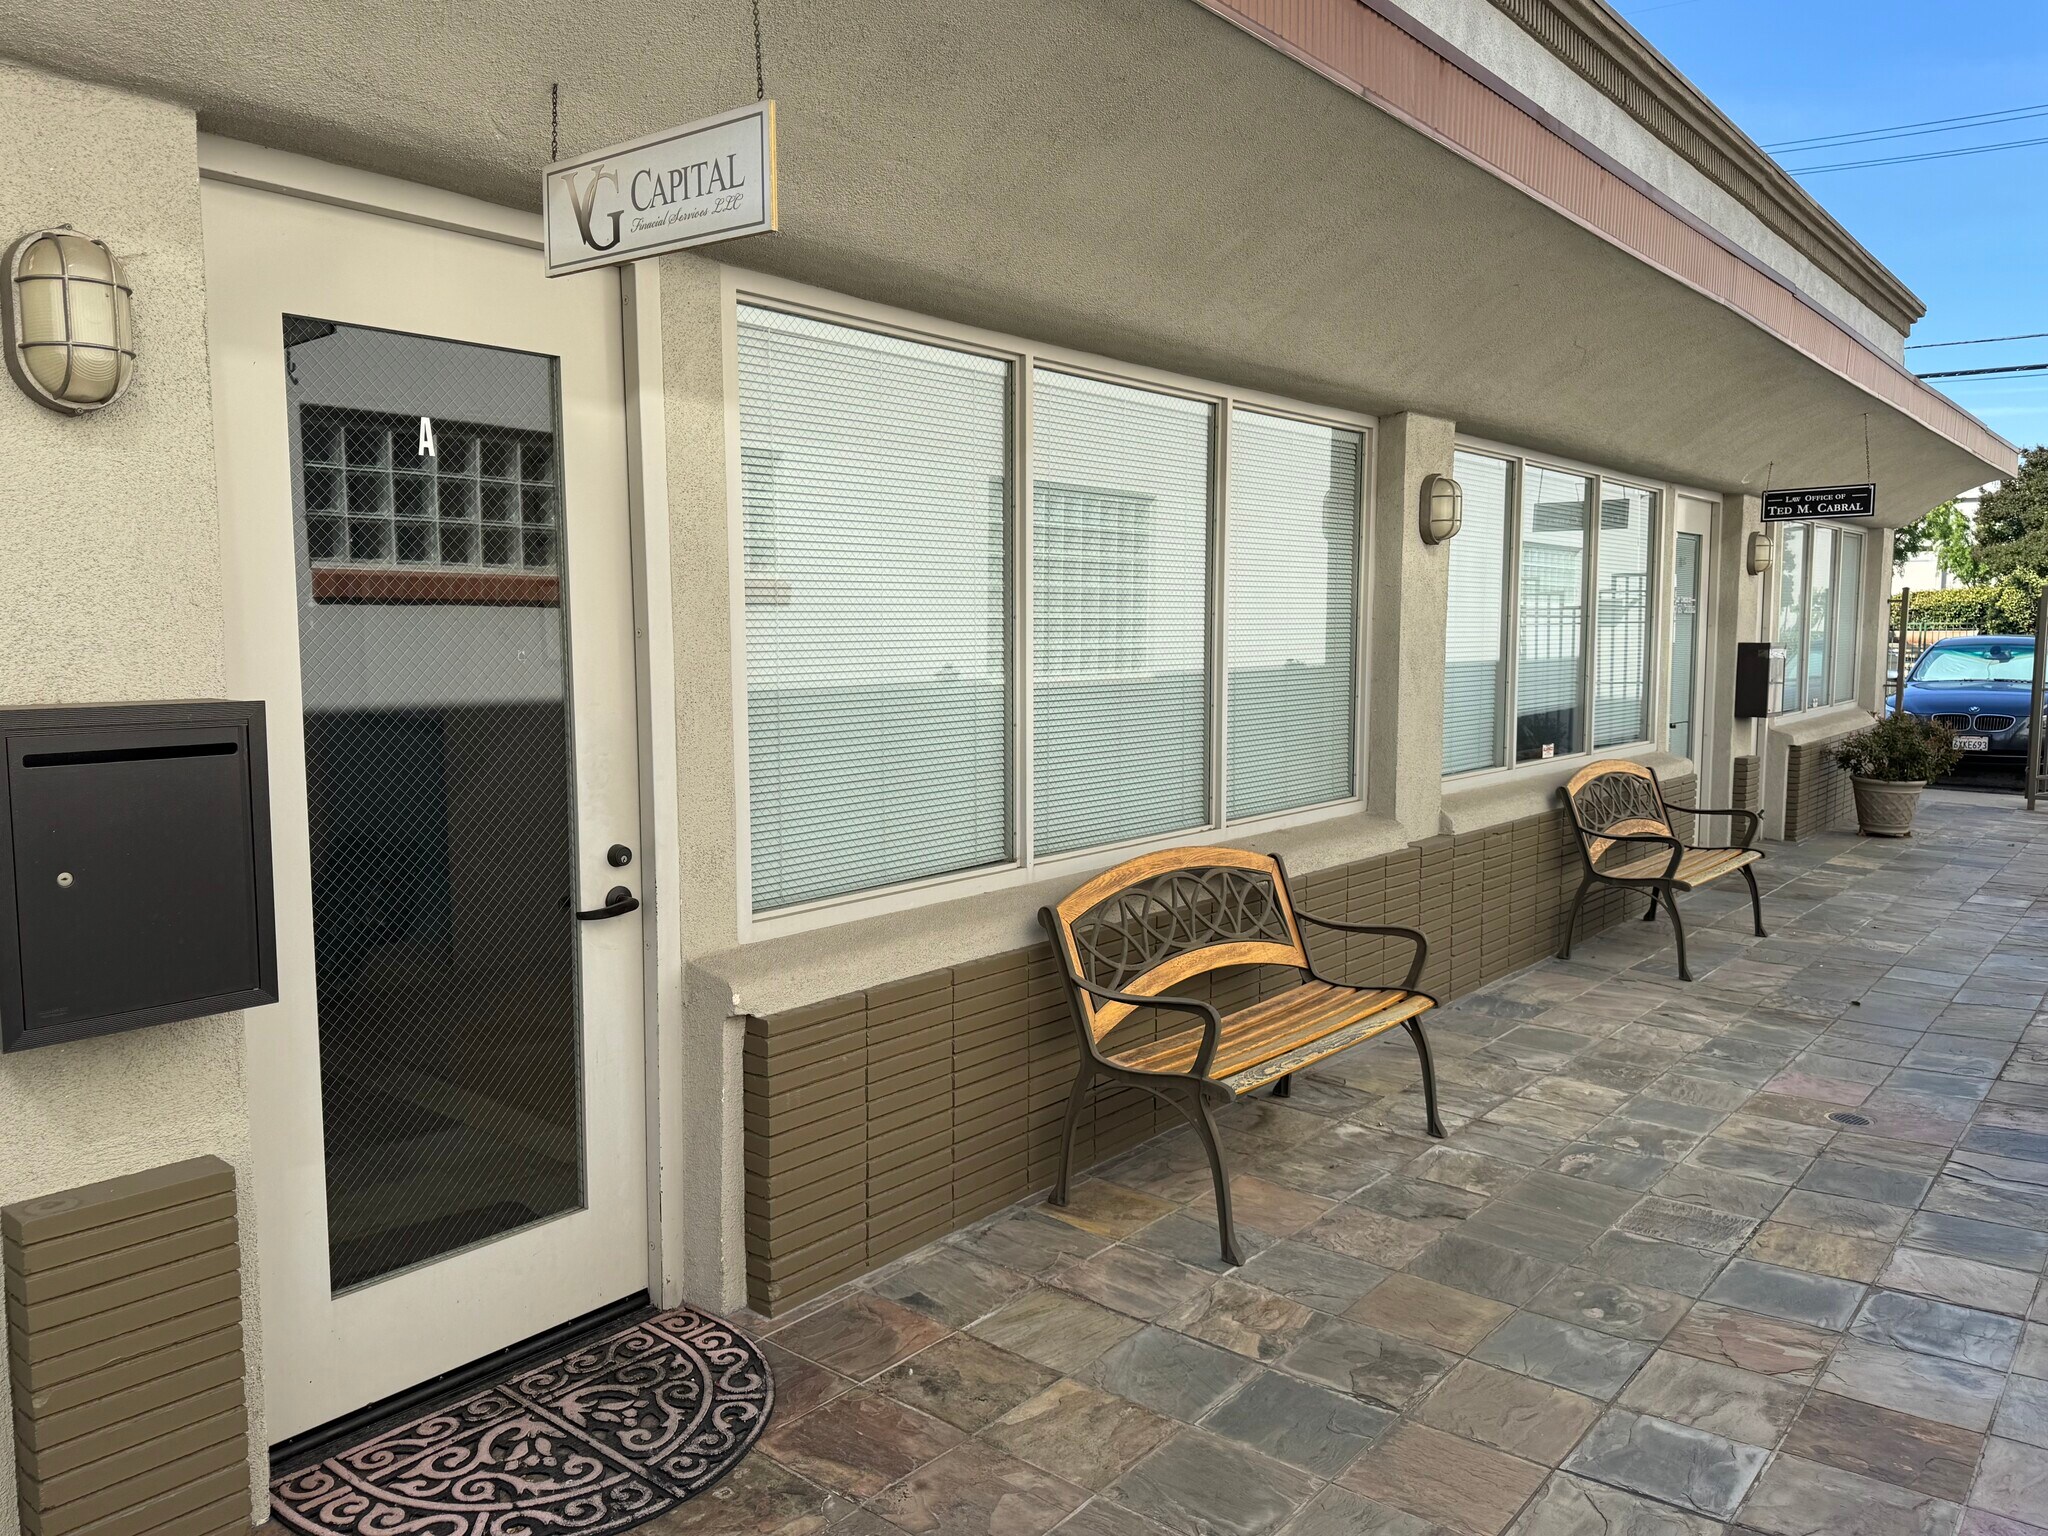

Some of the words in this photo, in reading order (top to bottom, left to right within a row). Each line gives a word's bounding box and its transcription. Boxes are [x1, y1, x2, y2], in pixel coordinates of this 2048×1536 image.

[631, 154, 746, 212] CAPITAL
[668, 207, 709, 226] Services
[711, 193, 744, 215] LLC
[418, 416, 436, 457] A
[1767, 506, 1792, 516] TED
[1797, 504, 1812, 514] M.
[1817, 502, 1864, 513] CABRAL
[1804, 494, 1833, 502] OFFICE
